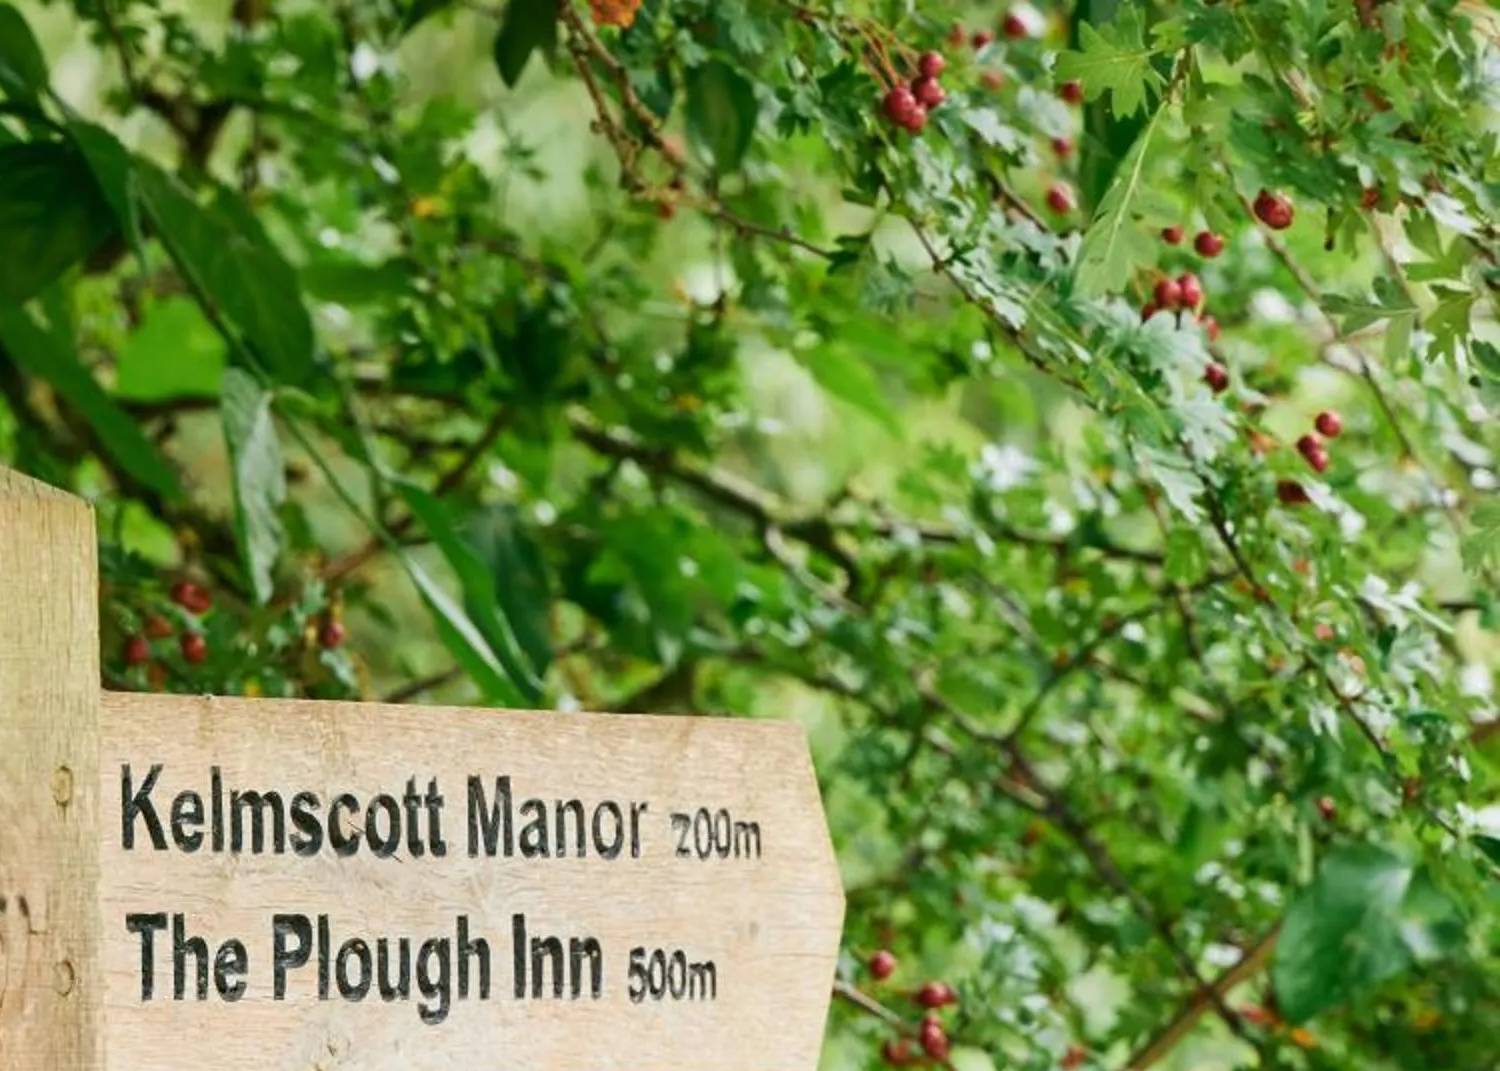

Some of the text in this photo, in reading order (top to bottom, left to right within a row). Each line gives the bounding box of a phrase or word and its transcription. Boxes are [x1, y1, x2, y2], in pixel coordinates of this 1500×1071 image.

[120, 765, 762, 861] Kelmscott Manor 200m
[126, 912, 719, 1026] The Plough Inn 500m
